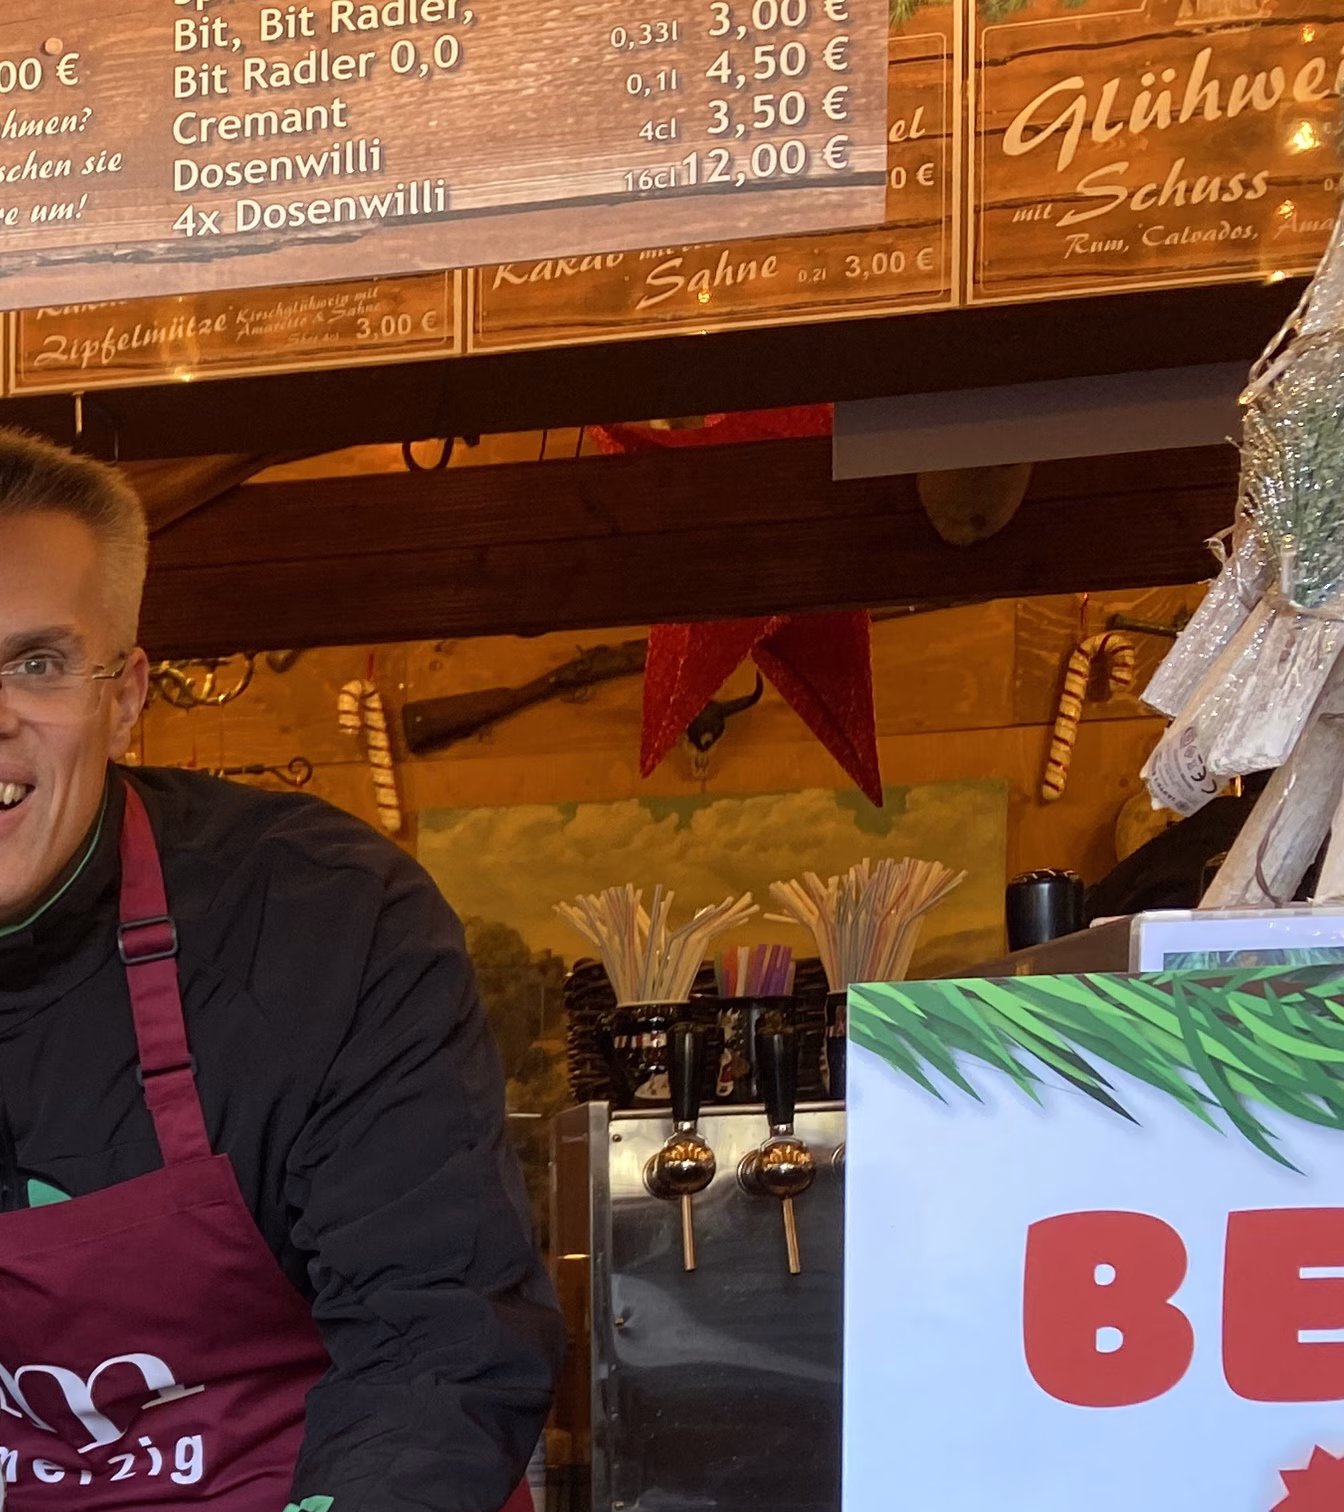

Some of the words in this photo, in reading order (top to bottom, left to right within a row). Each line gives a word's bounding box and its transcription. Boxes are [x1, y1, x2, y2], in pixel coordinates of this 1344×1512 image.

[174, 16, 242, 52] Bit,
[261, 5, 315, 42] Bit
[331, 0, 474, 34] Radler,
[174, 62, 228, 99] Bit
[244, 48, 375, 91] Radler
[390, 34, 459, 78] 0,0
[610, 20, 678, 50] 0,33l
[708, 0, 807, 40] 3,00
[823, 0, 849, 21] €
[56, 52, 79, 86] €
[172, 97, 347, 146] Cremant
[626, 69, 677, 97] 0,1l
[705, 41, 807, 90] 4,50
[823, 36, 849, 71] €
[174, 137, 381, 192] Dosenwilli
[639, 118, 677, 141] 4cl
[707, 90, 806, 139] 3,50
[821, 85, 848, 120] €
[888, 105, 926, 142] el
[81, 150, 122, 176] sie
[172, 204, 221, 237] 4x
[236, 178, 446, 233] Dosenwilli
[623, 166, 676, 192] 16cl
[682, 140, 806, 187] 12,00
[823, 134, 849, 169] €
[890, 166, 907, 189] 0
[916, 162, 934, 186] €
[30, 193, 88, 223] um!
[1012, 203, 1053, 223] mit
[1056, 157, 1269, 227] Schuss
[1064, 233, 1129, 259] Rum,
[1142, 219, 1260, 246] Calvados,
[635, 249, 779, 310] Sahne
[845, 250, 906, 280] 3,00
[915, 247, 933, 272] €
[33, 313, 228, 369] Zipfelmütze
[356, 314, 411, 341] 3,00
[422, 311, 437, 332] €
